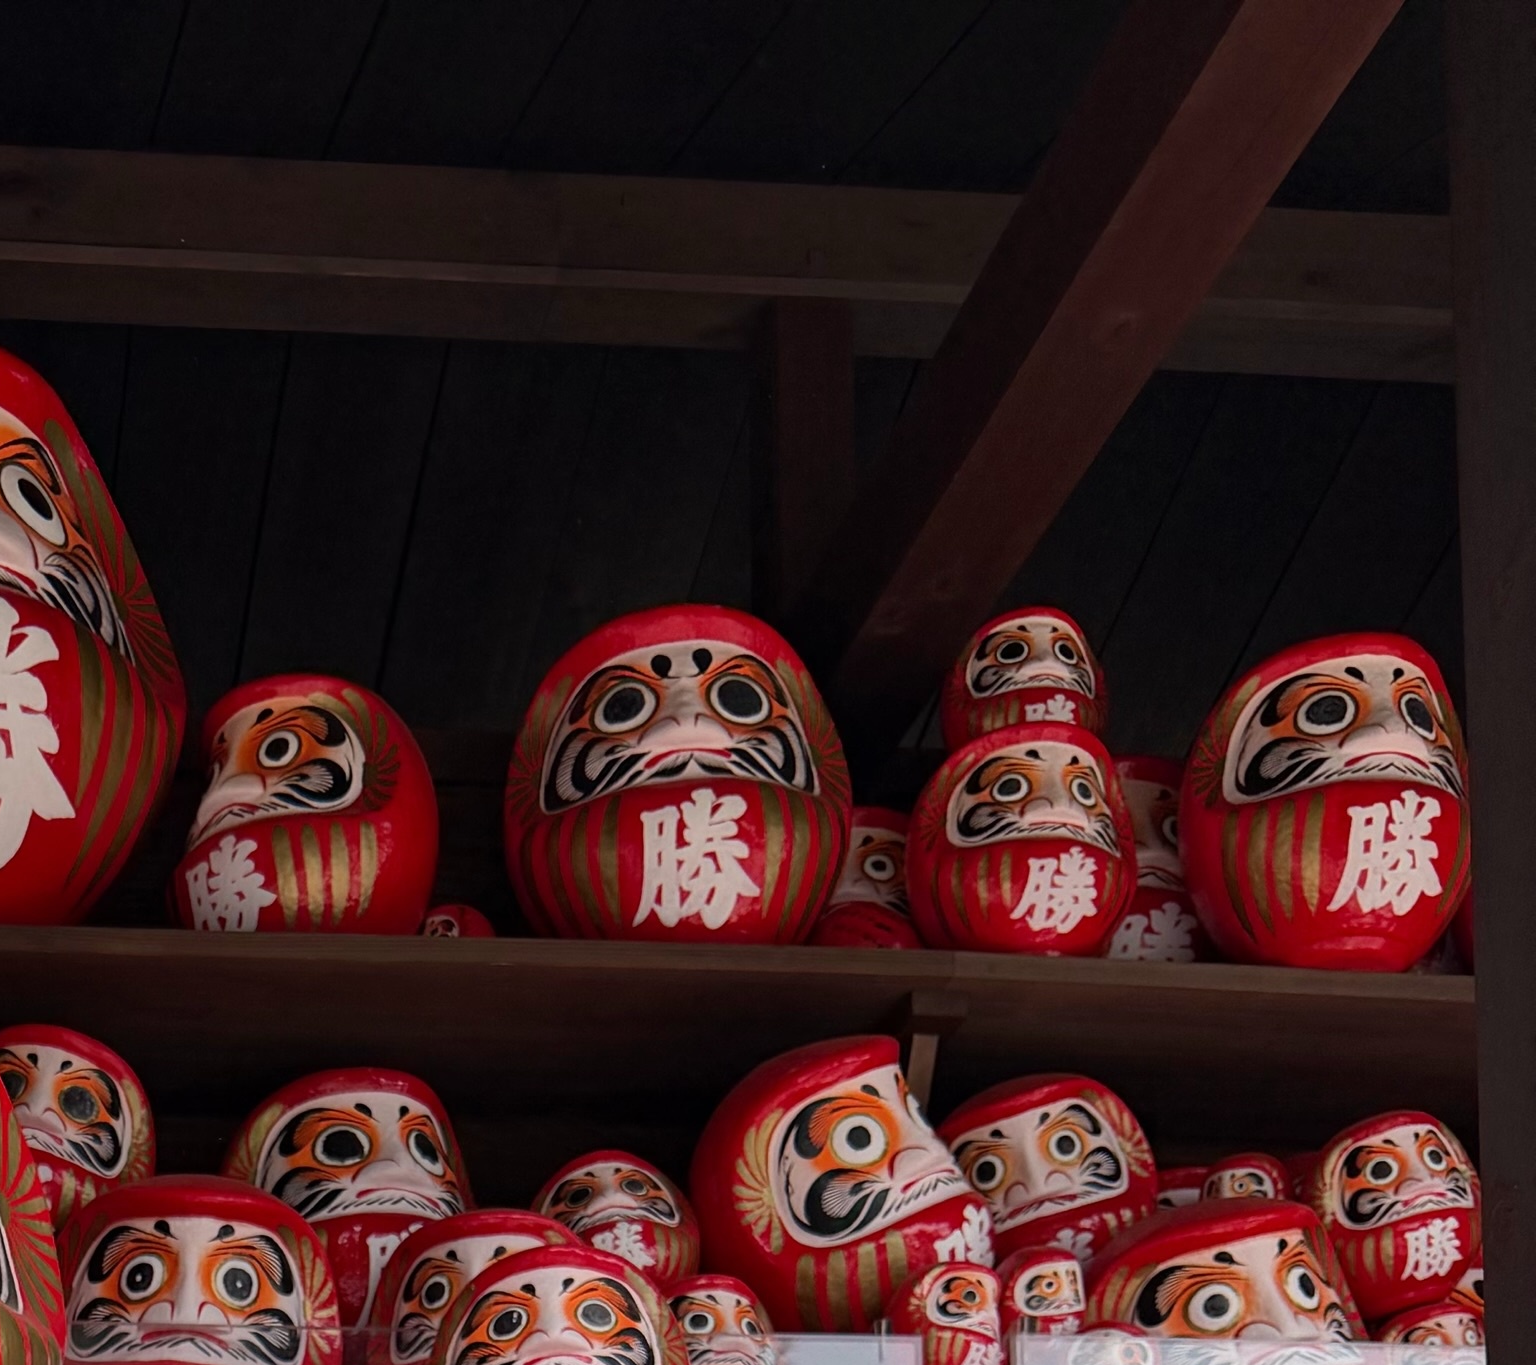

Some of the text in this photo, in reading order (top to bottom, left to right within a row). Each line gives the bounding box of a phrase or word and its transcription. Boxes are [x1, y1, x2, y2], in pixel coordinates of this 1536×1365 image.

[184, 833, 277, 932] 勝
[632, 788, 760, 930] 勝
[1010, 846, 1098, 933] 勝
[1327, 790, 1443, 917] 勝
[591, 1221, 656, 1271] 勝
[1400, 1217, 1463, 1281] 勝
